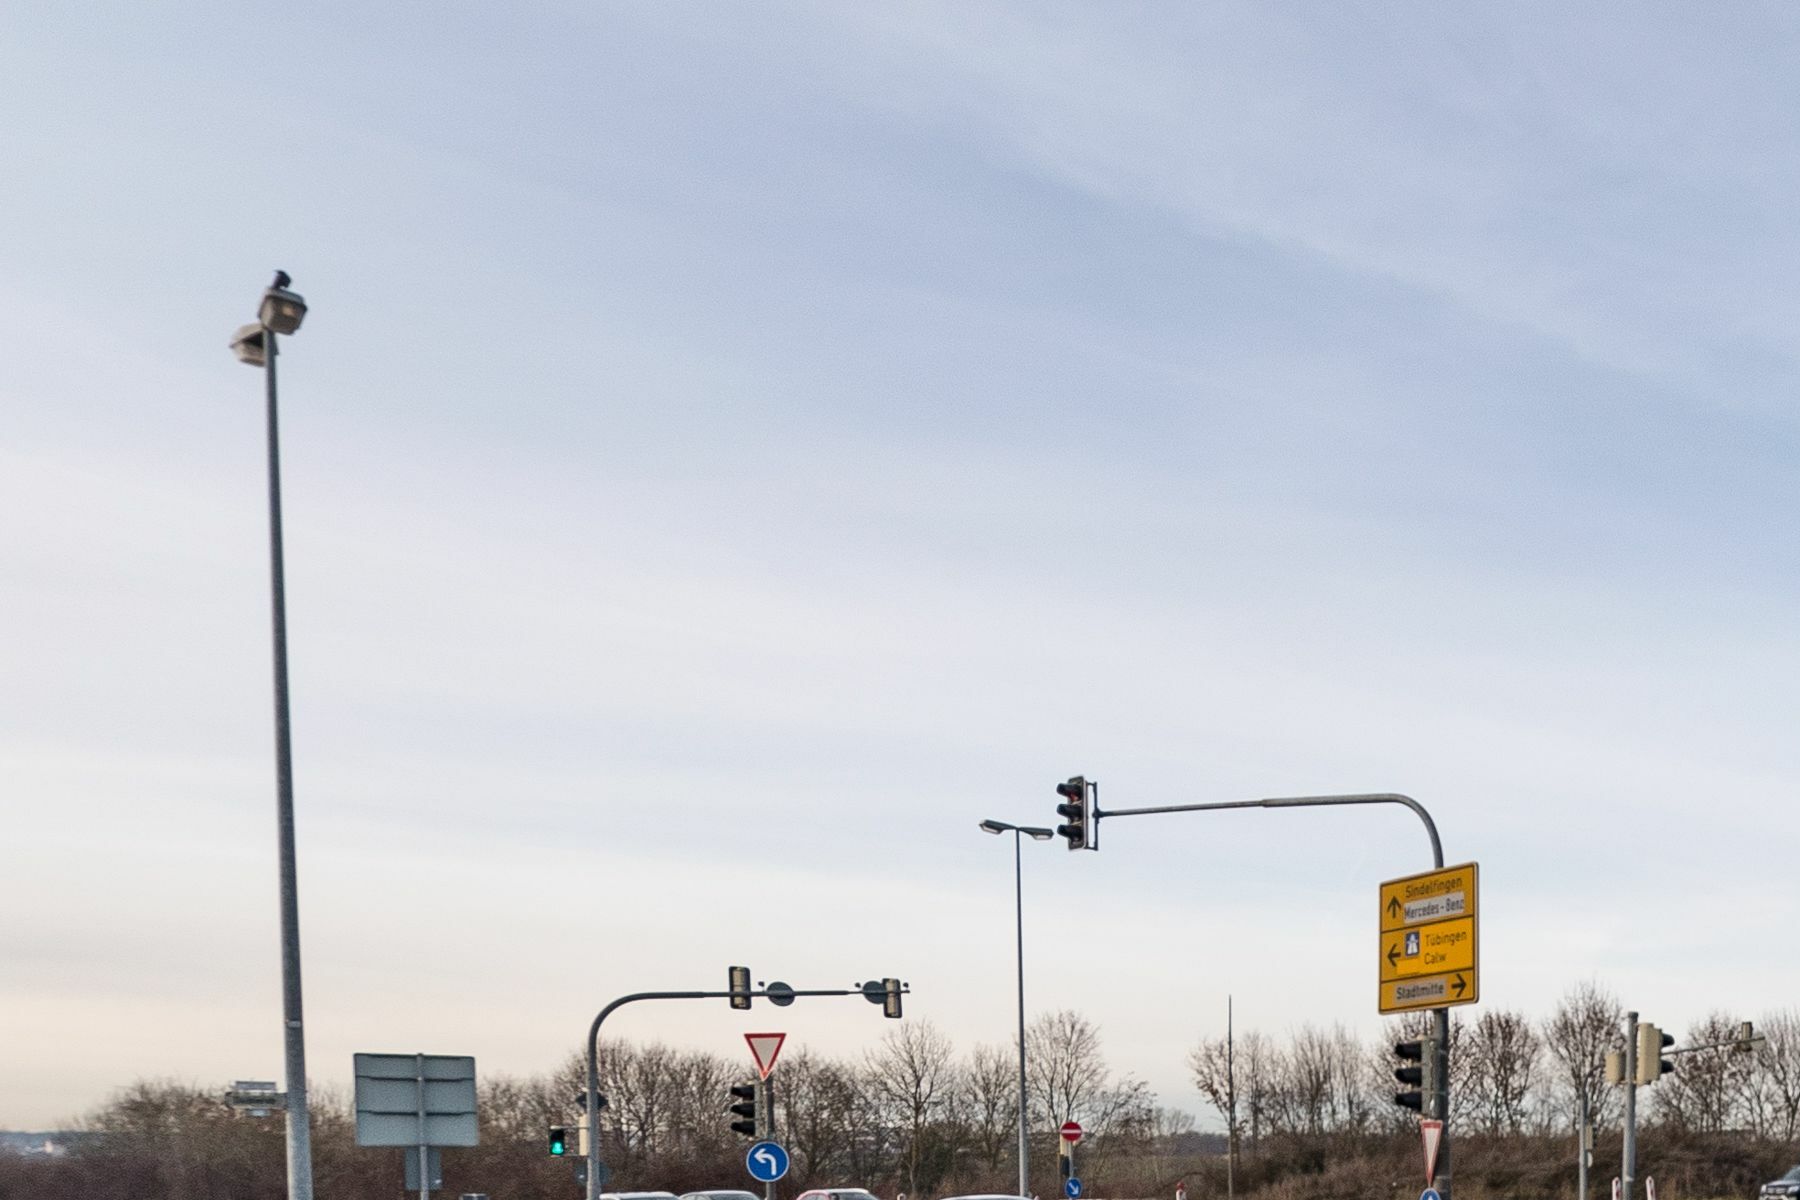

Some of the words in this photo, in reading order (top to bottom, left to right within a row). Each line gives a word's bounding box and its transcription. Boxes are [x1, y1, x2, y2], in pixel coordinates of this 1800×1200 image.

[1405, 878, 1462, 898] Sindelfingen
[1425, 932, 1467, 946] Tübingen
[1424, 952, 1446, 965] Calw
[1396, 983, 1444, 1000] Stadtmitte
